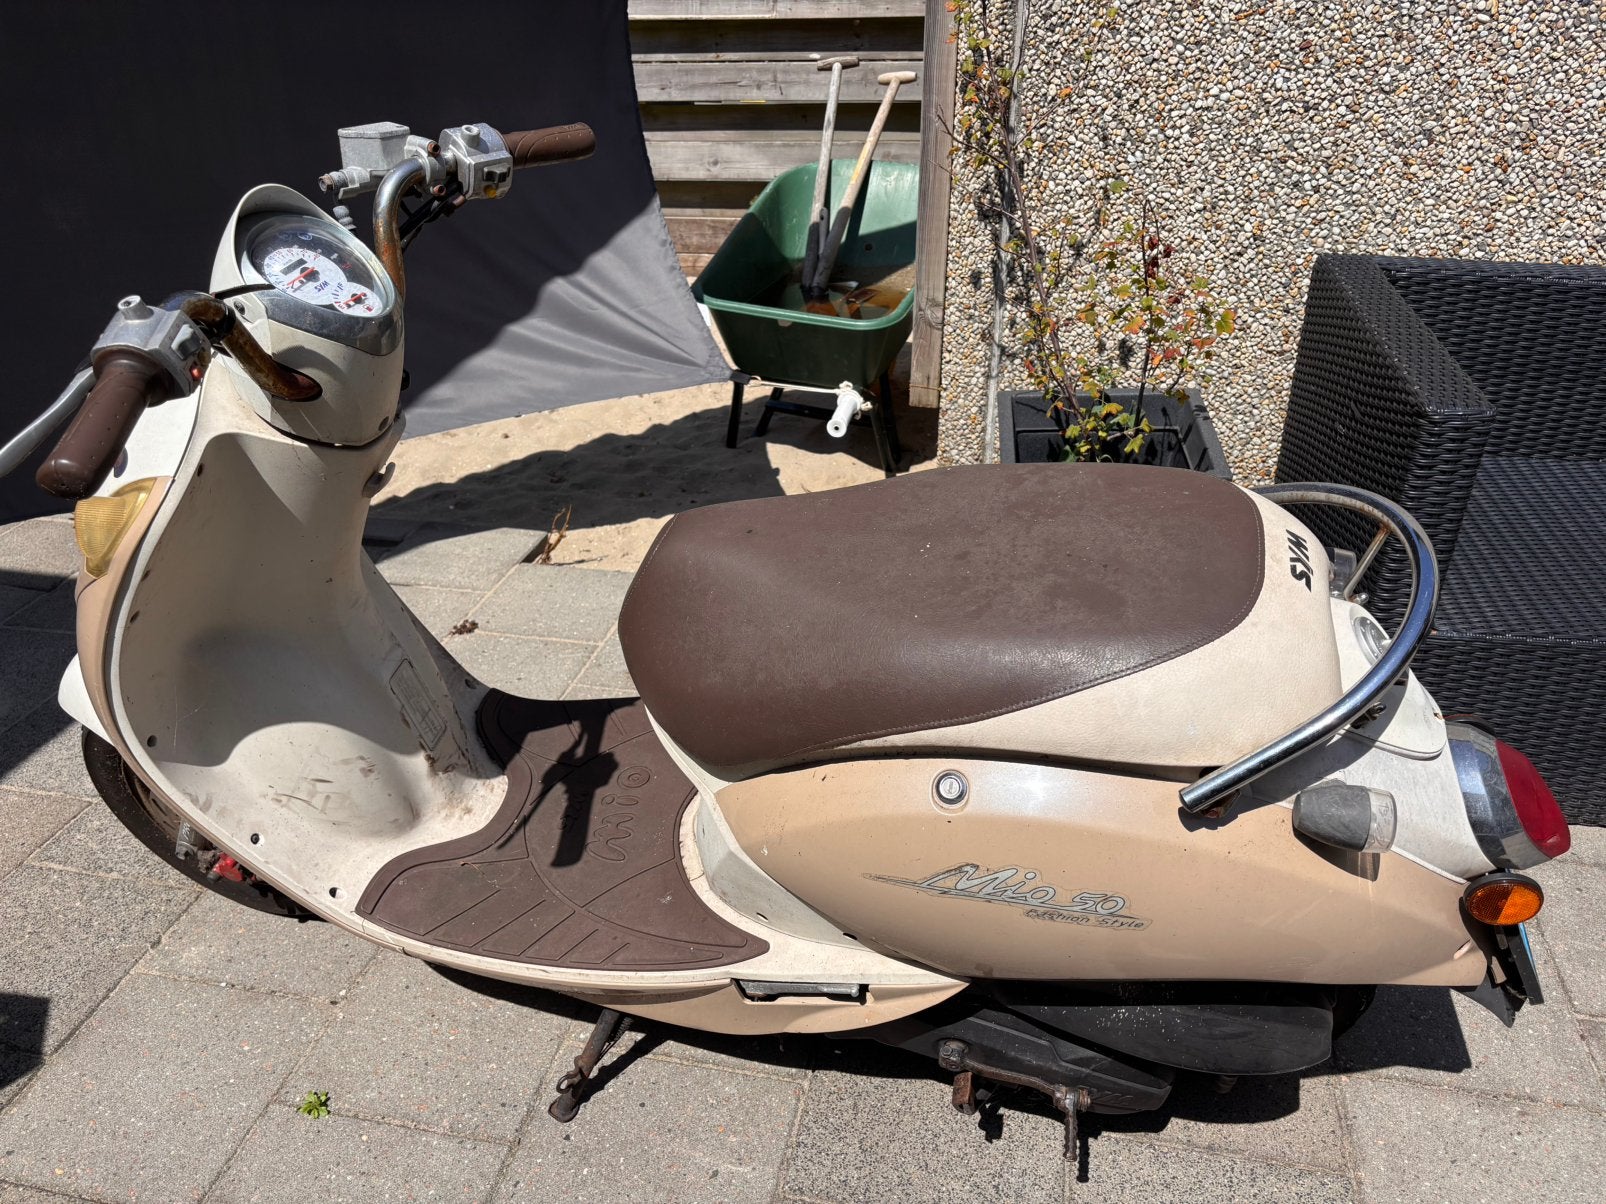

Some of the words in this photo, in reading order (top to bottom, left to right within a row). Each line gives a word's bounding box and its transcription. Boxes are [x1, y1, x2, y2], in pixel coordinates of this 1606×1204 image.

[314, 280, 330, 293] SYM
[1286, 529, 1313, 592] SYM
[918, 863, 1057, 903] Mio
[1072, 892, 1126, 915] 50
[1026, 908, 1090, 924] Fashion
[1100, 917, 1145, 929] Style
